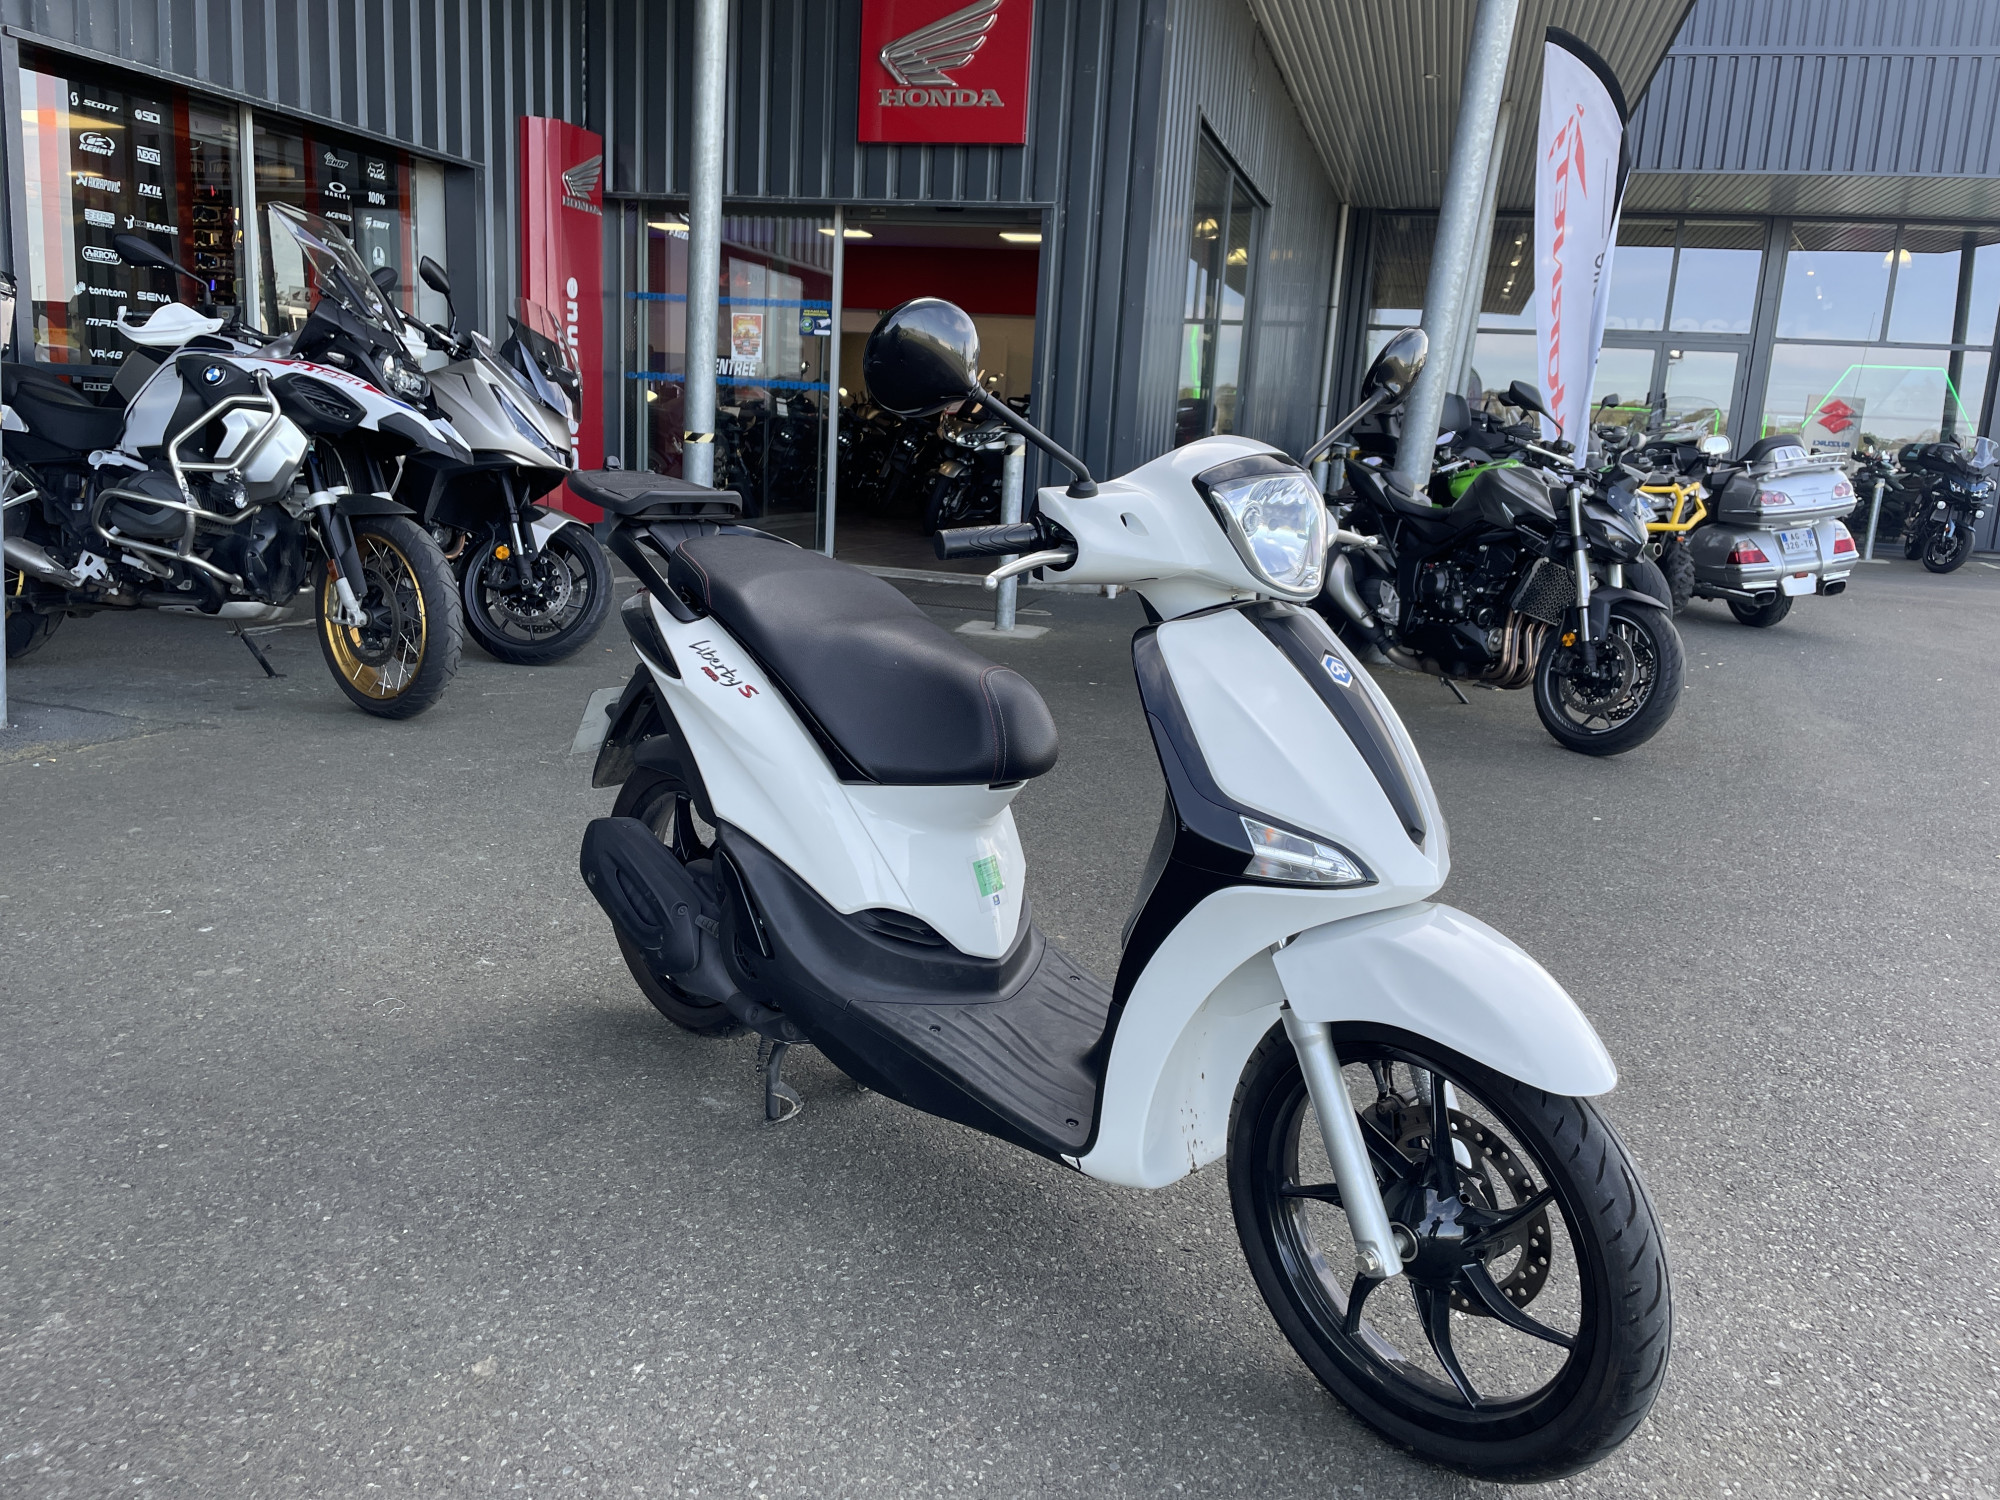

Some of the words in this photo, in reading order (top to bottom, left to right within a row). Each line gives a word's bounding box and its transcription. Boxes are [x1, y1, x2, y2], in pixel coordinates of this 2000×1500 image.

[878, 89, 1005, 107] HONDA
[83, 99, 119, 113] SCOTT
[79, 143, 114, 156] KENNY
[138, 182, 162, 196] IXIL
[324, 190, 351, 201] OAKLEY
[368, 191, 386, 206] 100%
[562, 195, 602, 216] HONDA
[85, 248, 118, 261] ARROW
[88, 286, 127, 298] tomtom
[137, 291, 172, 303] SENA
[689, 640, 743, 687] Liberty
[738, 684, 760, 698] S
